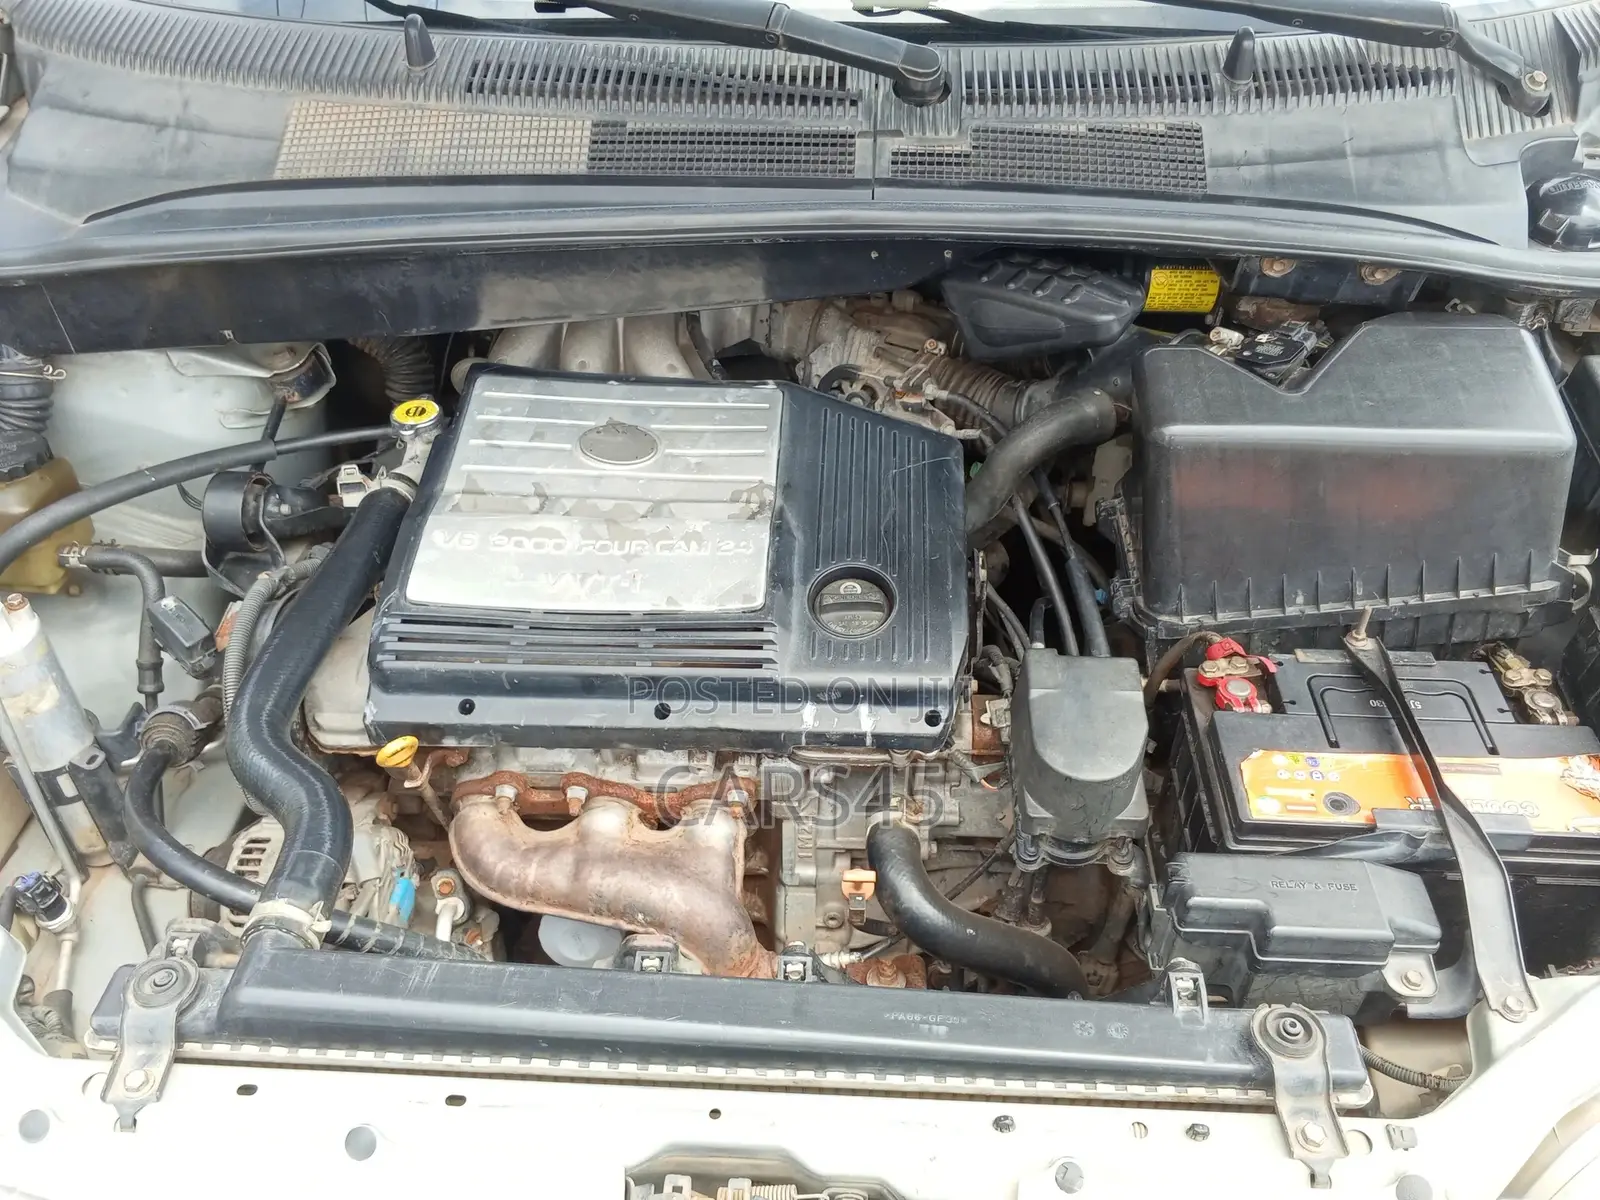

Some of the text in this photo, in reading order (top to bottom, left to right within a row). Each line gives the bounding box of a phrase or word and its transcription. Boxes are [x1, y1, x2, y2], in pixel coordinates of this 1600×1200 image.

[577, 539, 649, 556] FOUR
[655, 540, 712, 556] CAM
[1270, 880, 1358, 892] RELAY & FUSE
